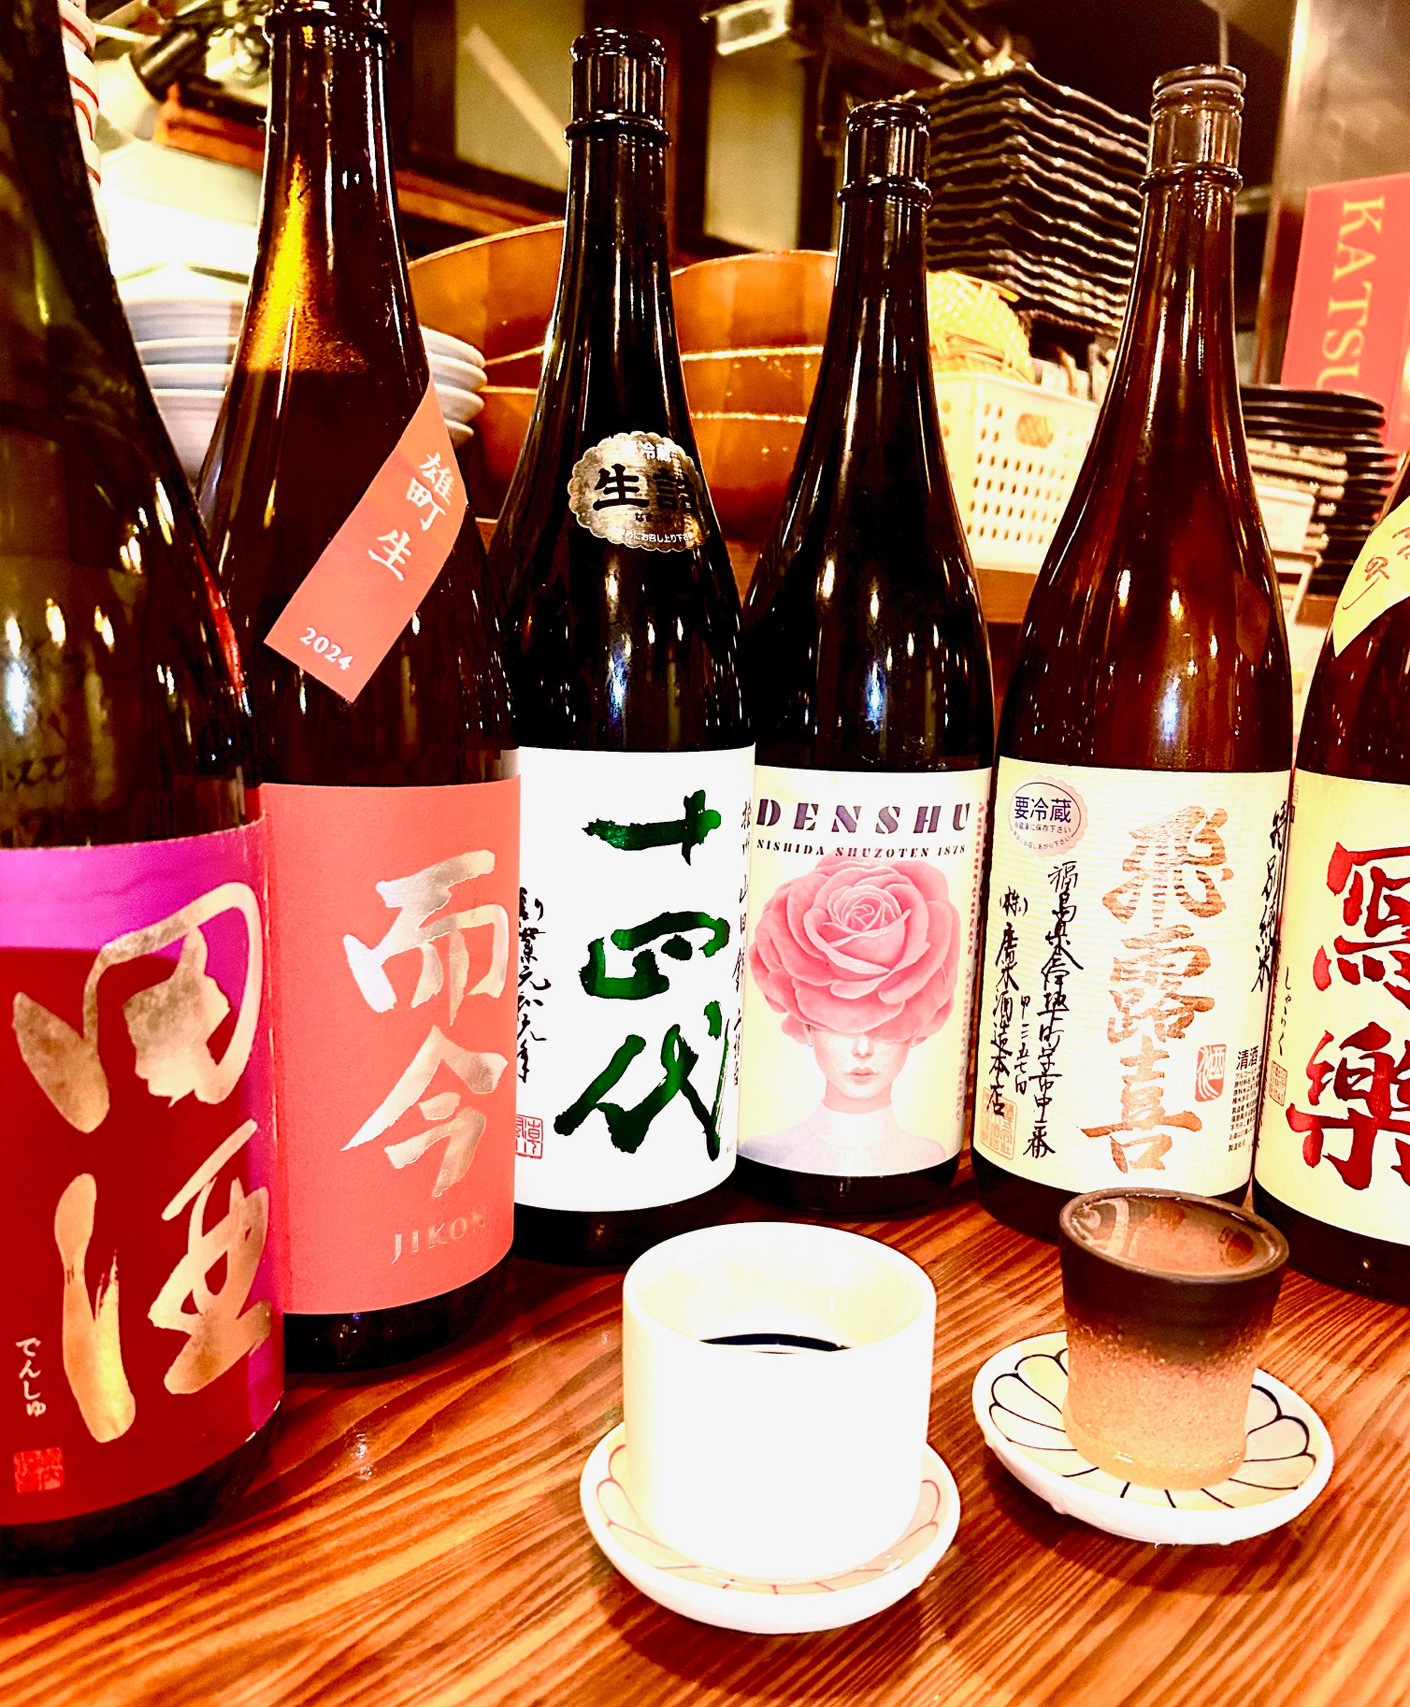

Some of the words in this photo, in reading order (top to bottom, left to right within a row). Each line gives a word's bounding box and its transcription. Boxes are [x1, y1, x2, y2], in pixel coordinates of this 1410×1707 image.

[406, 451, 455, 531] 雄町
[368, 529, 411, 581] 生
[300, 627, 354, 671] 2024
[755, 798, 971, 835] DENSHU
[1014, 796, 1072, 823] 要冷蔵
[756, 839, 825, 856] NISHIDA
[835, 846, 929, 858] SHUZOTEN
[937, 844, 966, 857] 1878
[553, 789, 730, 1161] 十四代
[1078, 805, 1234, 1174] 飛露喜
[341, 849, 509, 1197] 而今
[391, 1208, 487, 1264] JIKON
[16, 1337, 47, 1416] でんしゅ
